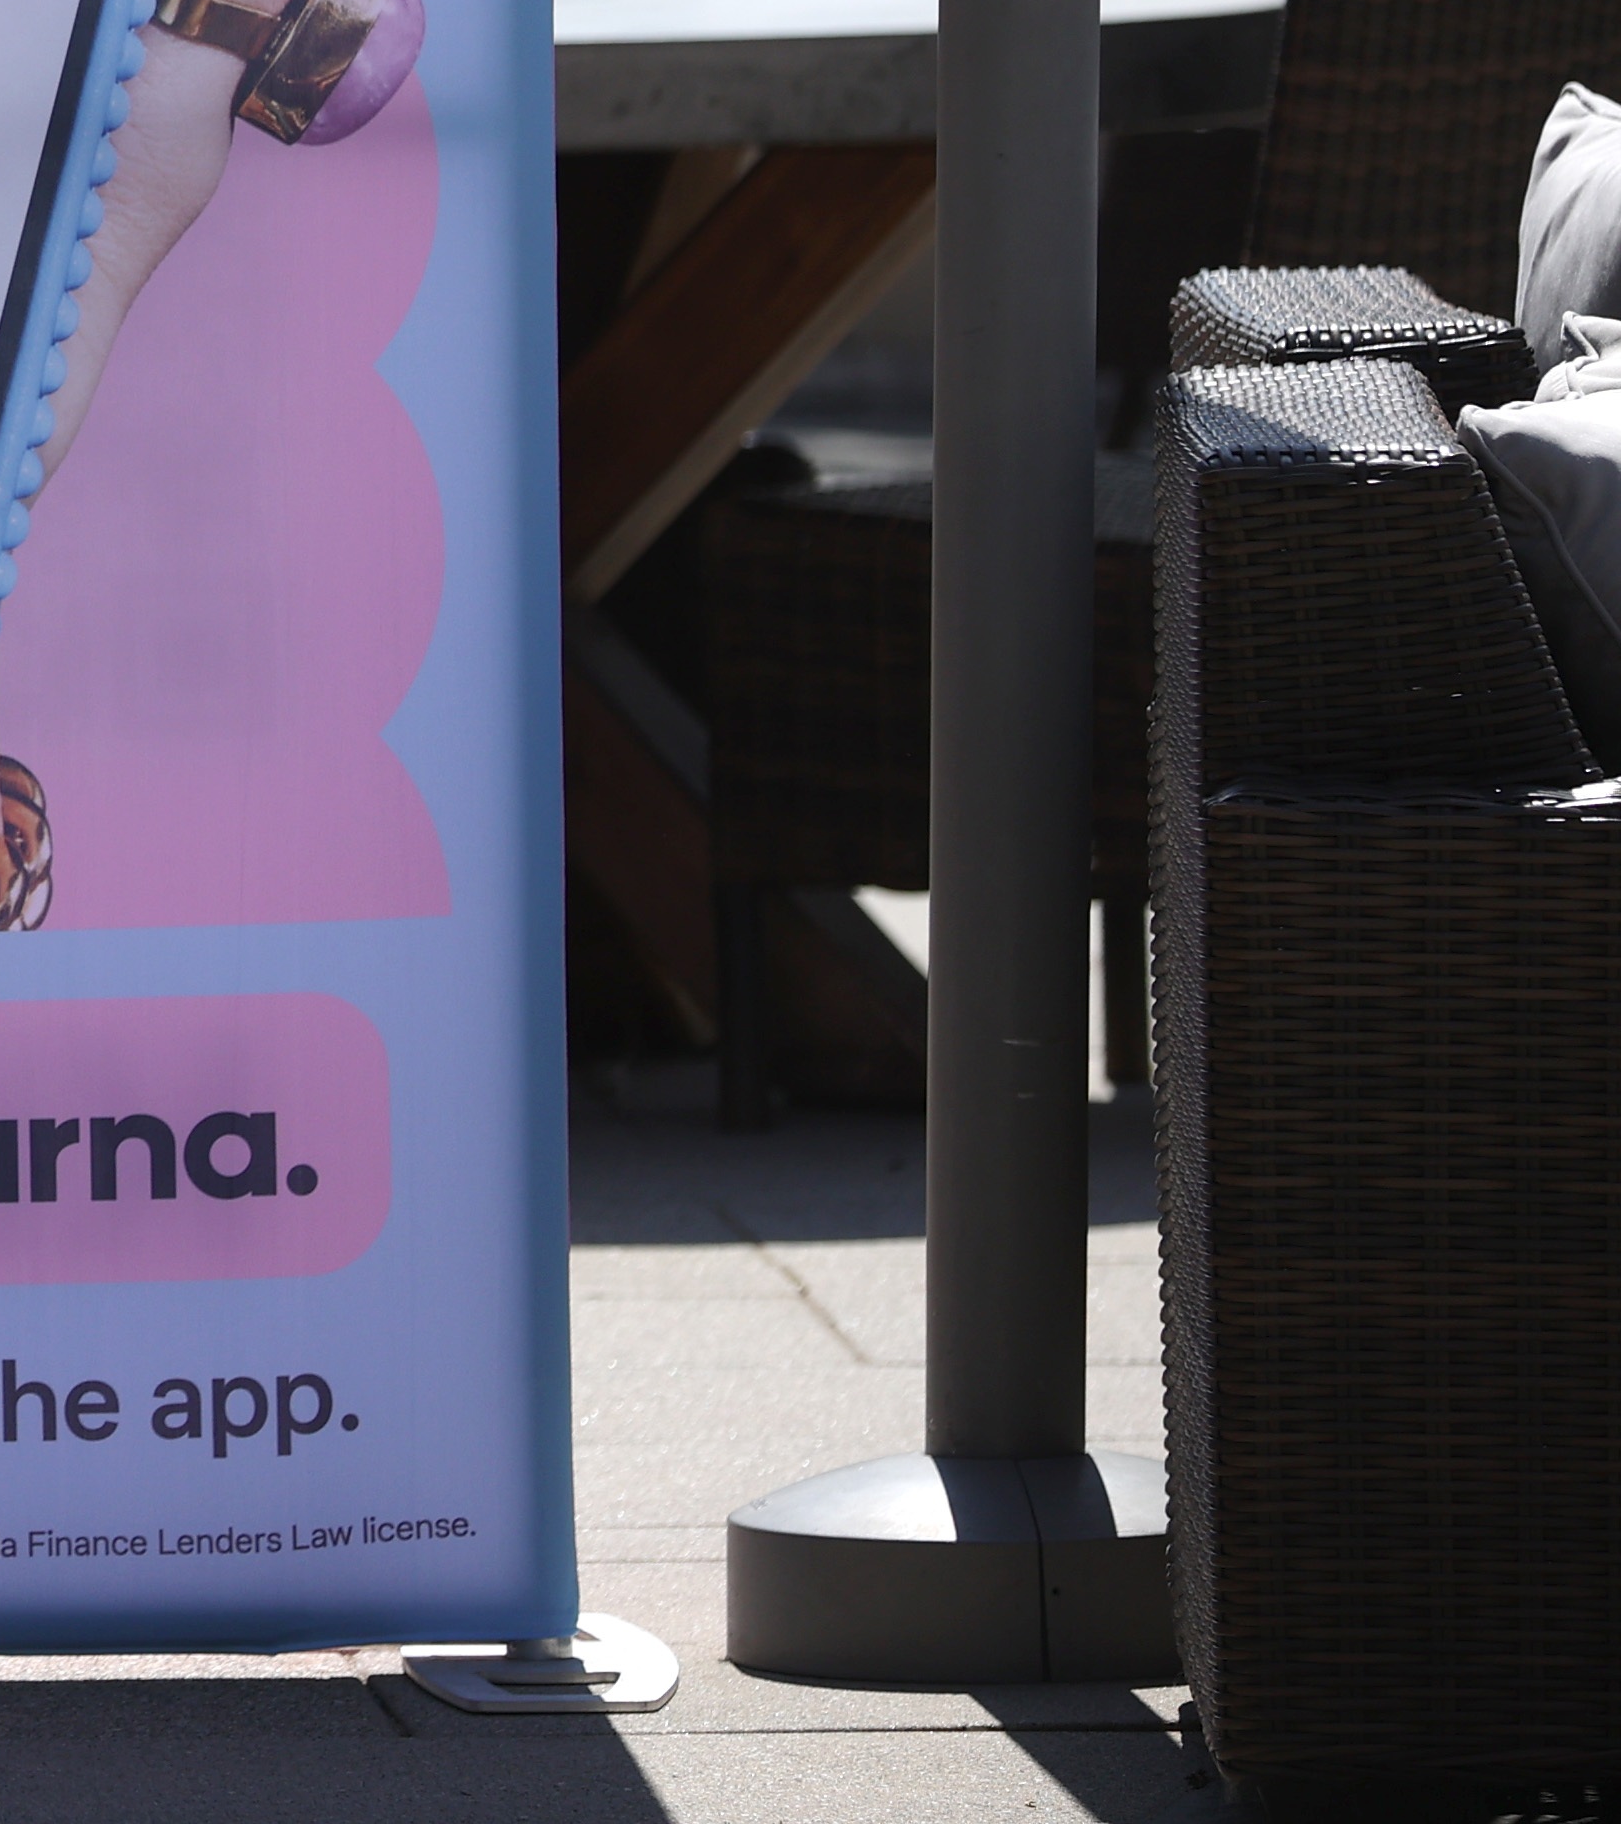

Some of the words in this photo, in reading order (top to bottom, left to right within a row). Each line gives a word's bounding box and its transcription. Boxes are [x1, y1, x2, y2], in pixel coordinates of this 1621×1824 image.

[151, 1373, 360, 1459] app.
[28, 1529, 148, 1558] Finance
[158, 1526, 283, 1556] Lenders
[291, 1524, 353, 1551] Law
[362, 1516, 477, 1545] license.
